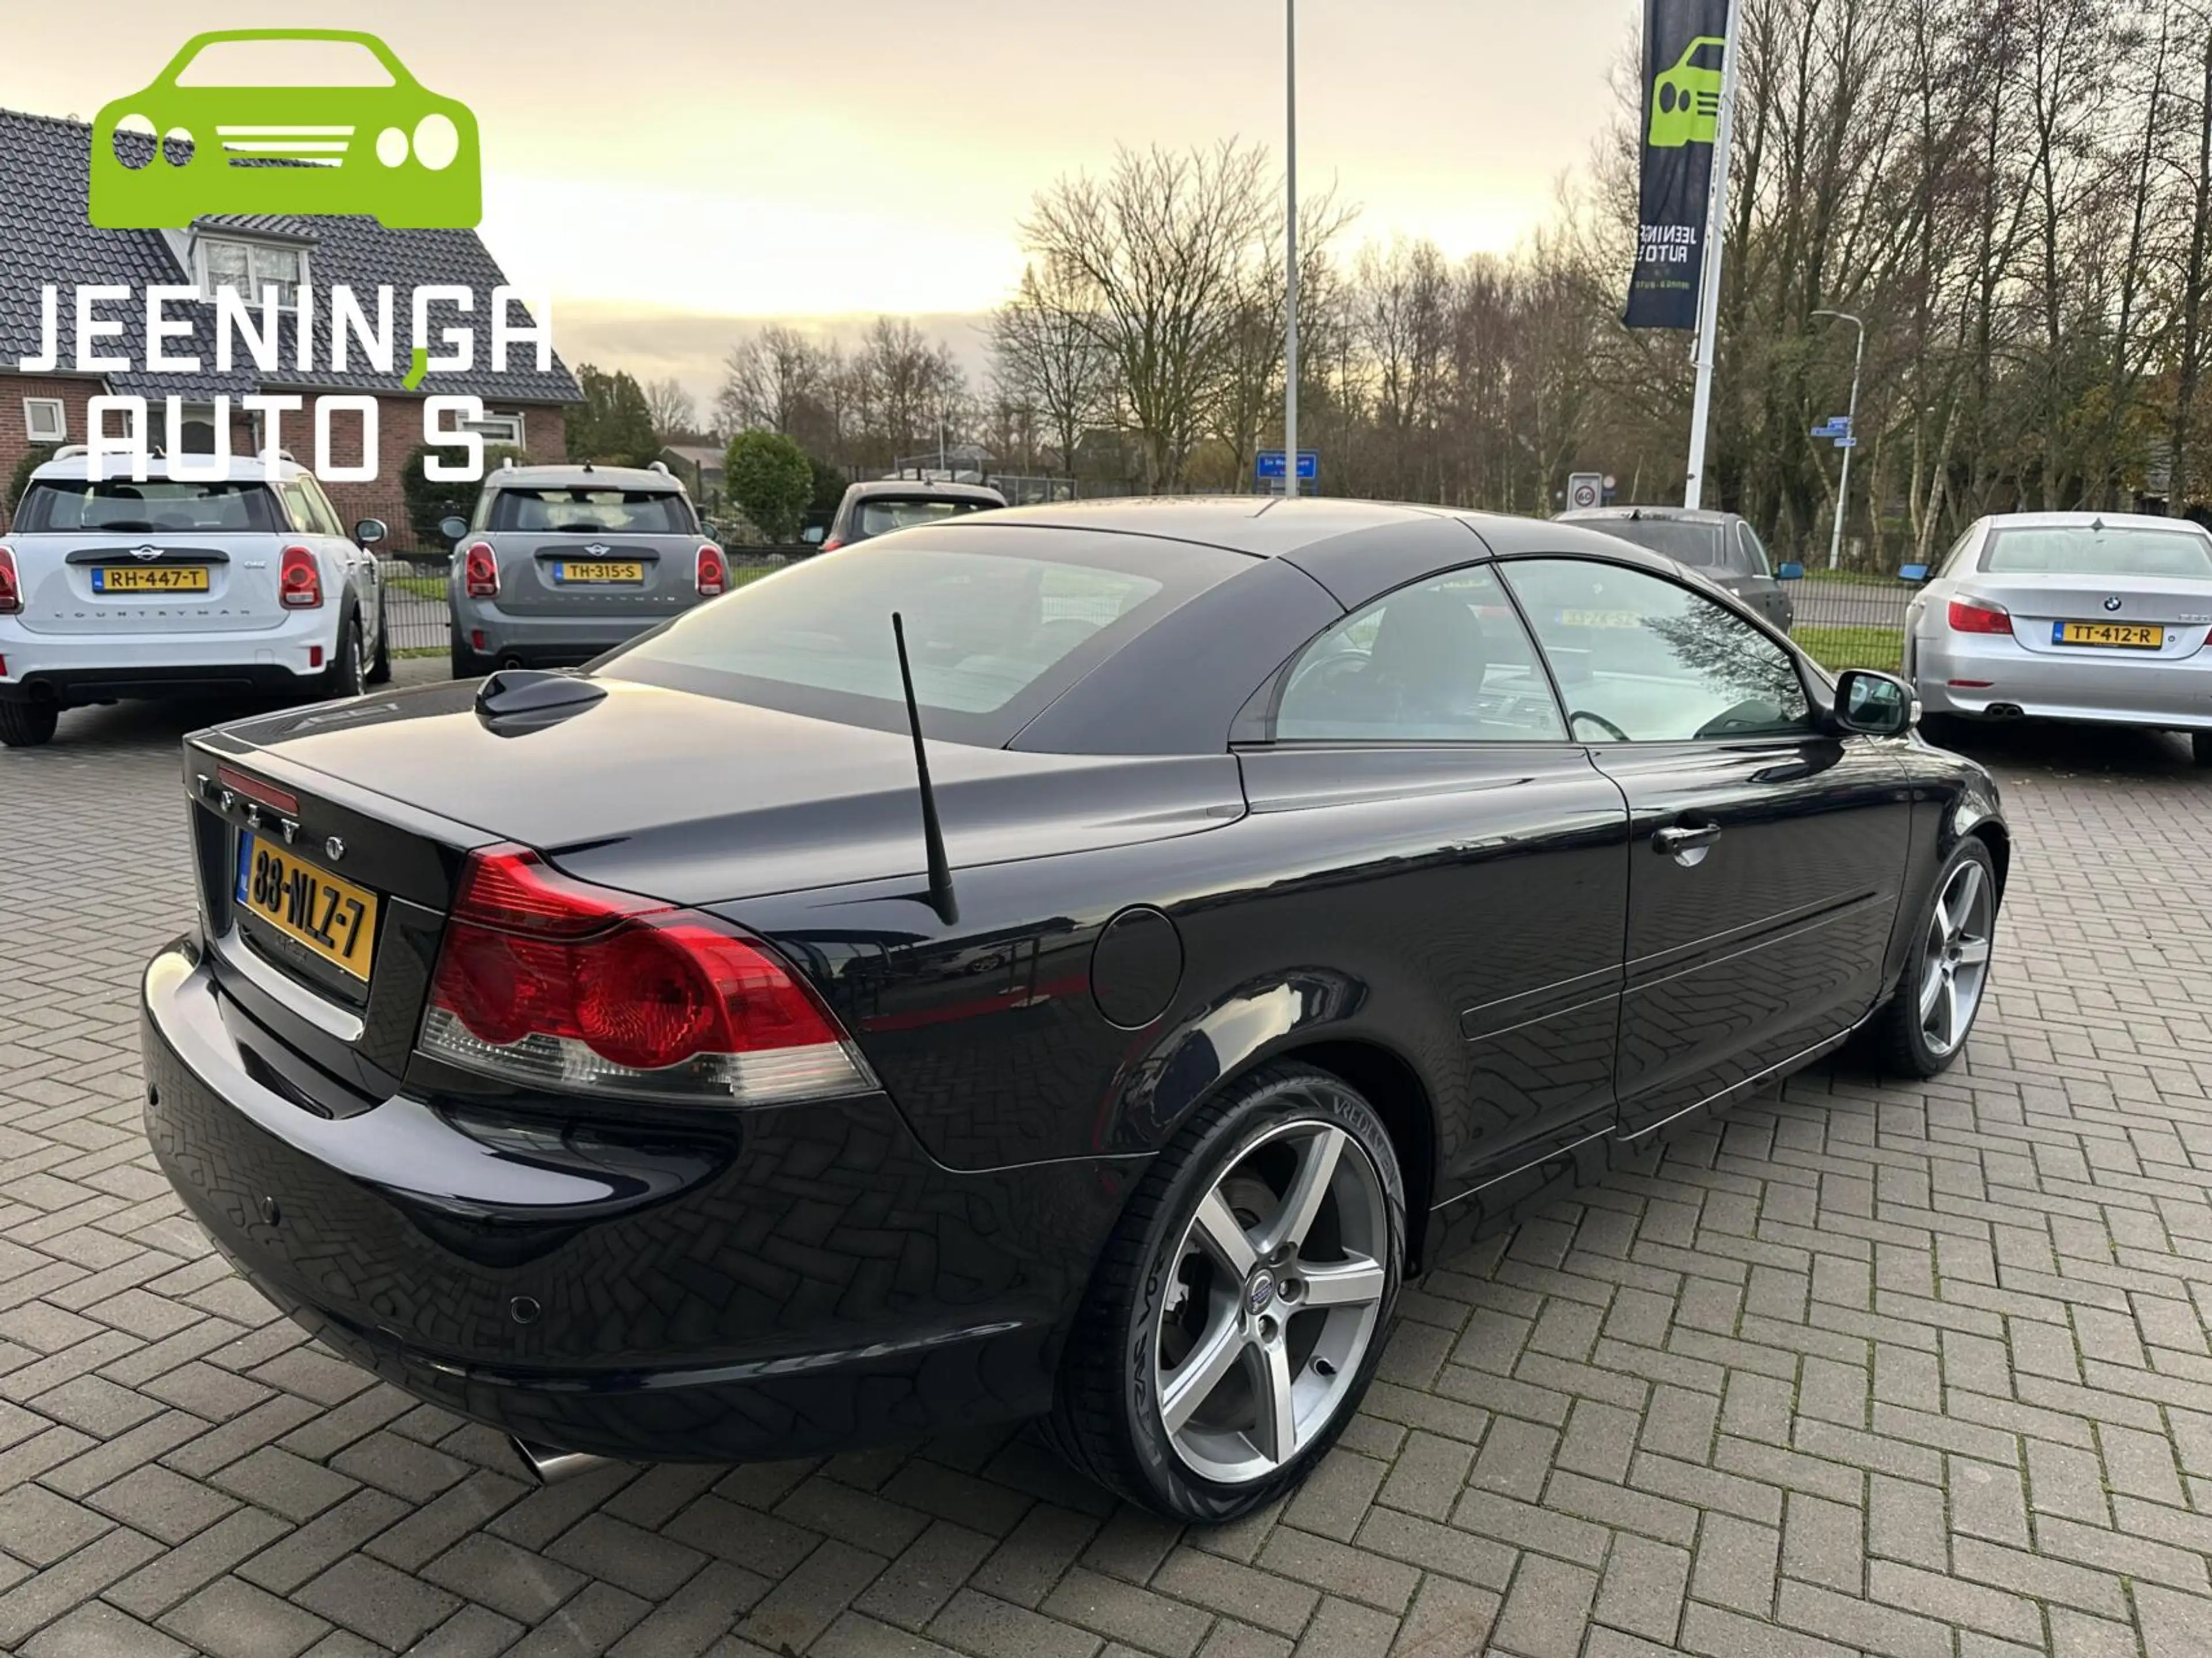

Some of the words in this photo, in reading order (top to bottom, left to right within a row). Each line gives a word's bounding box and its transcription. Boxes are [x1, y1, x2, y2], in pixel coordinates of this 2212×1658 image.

[1579, 492, 1591, 501] 60
[111, 571, 200, 586] RH-447-T
[570, 565, 635, 578] TH-315-S
[2073, 625, 2150, 643] TT-412-R
[197, 775, 345, 861] VOLVO
[254, 850, 365, 959] 88-NLZ-7
